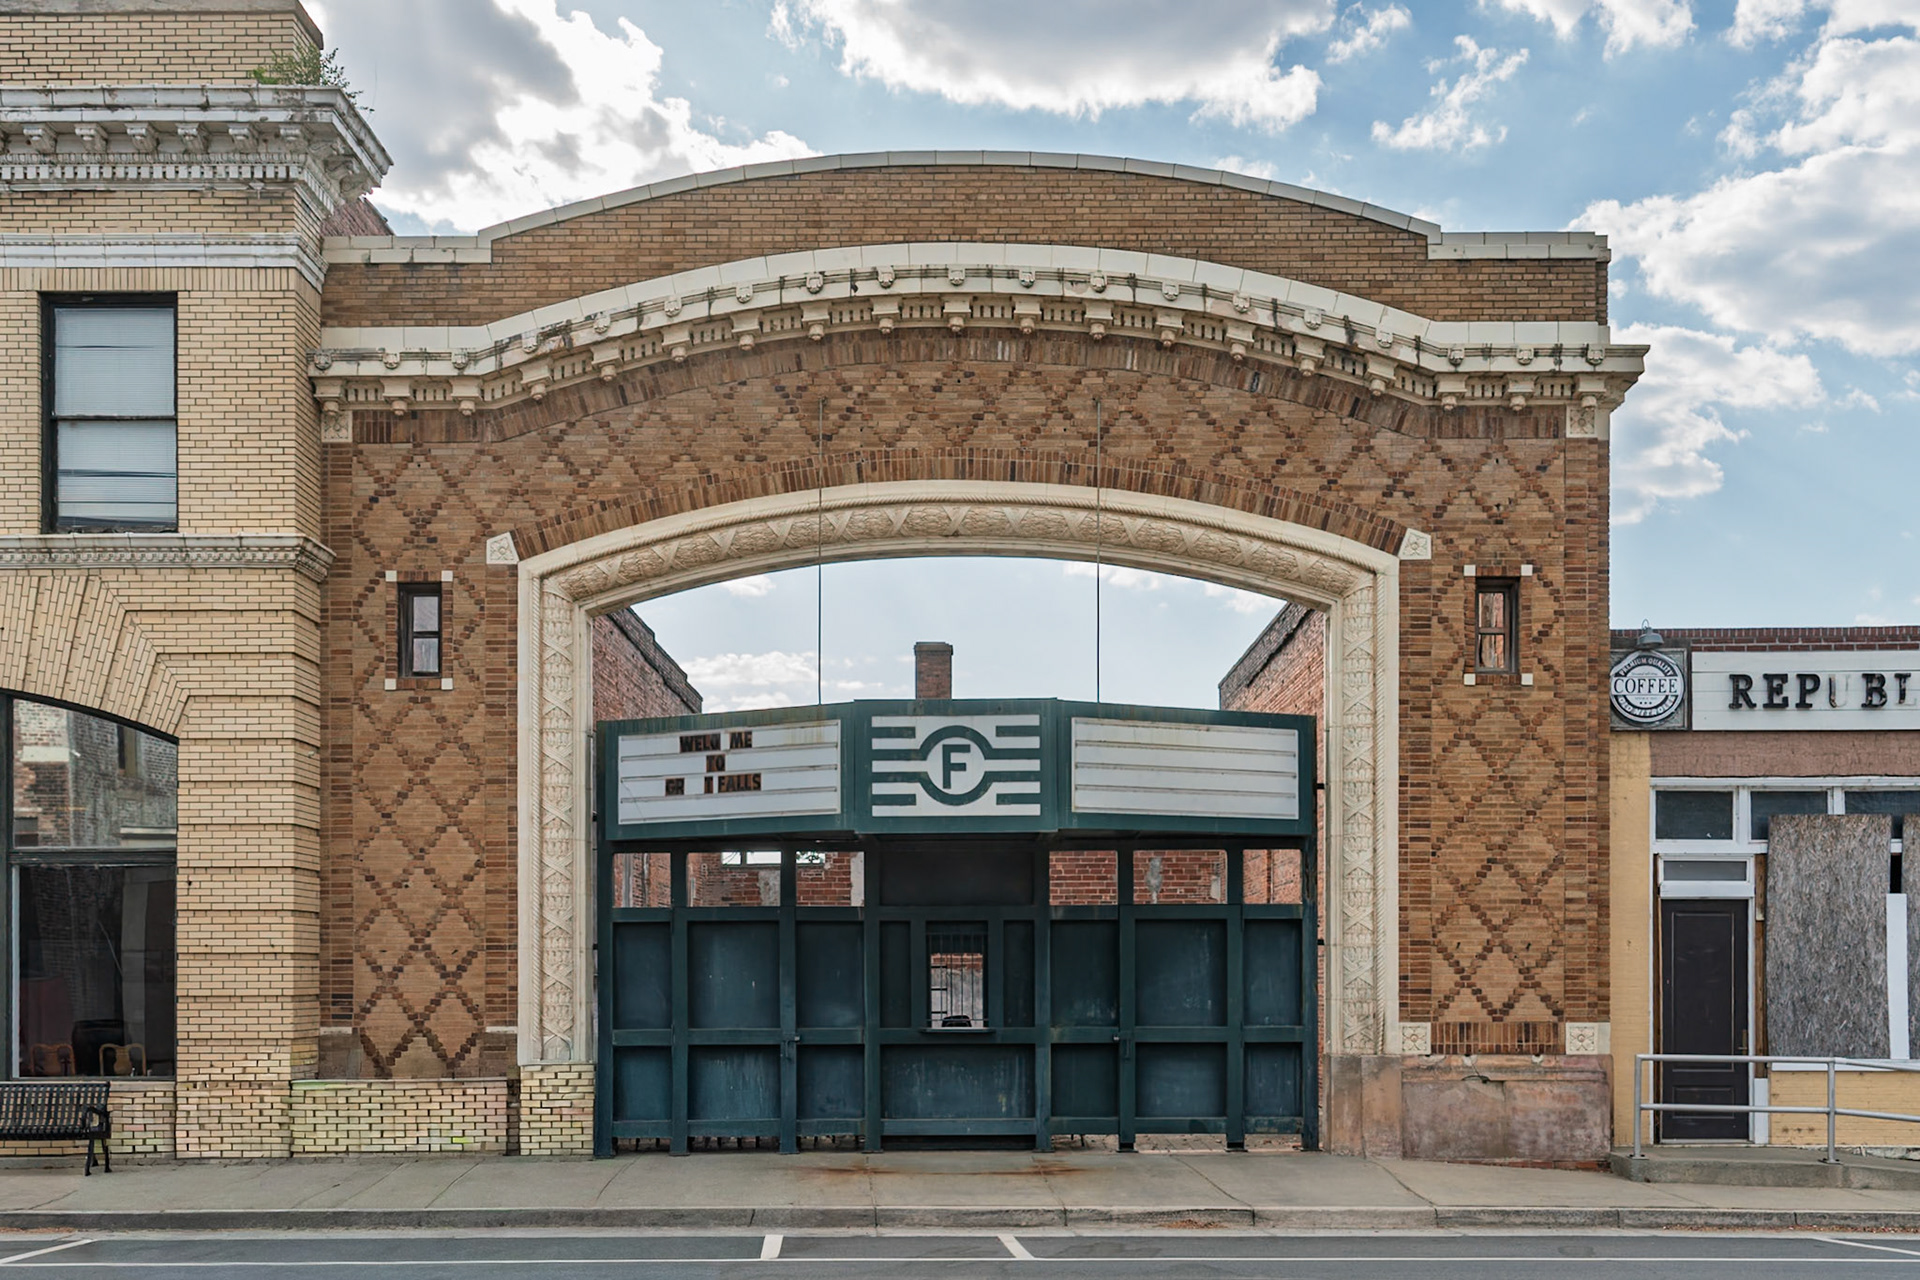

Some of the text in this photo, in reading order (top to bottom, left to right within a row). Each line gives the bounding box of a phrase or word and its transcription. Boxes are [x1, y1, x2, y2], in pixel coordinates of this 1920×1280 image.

[1619, 658, 1673, 676] PREMIUM QUALITY
[1614, 678, 1678, 694] COFFEE
[1618, 697, 1634, 712] OLD
[706, 754, 725, 772] TO
[942, 744, 971, 789] F
[718, 773, 761, 792] FALLS
